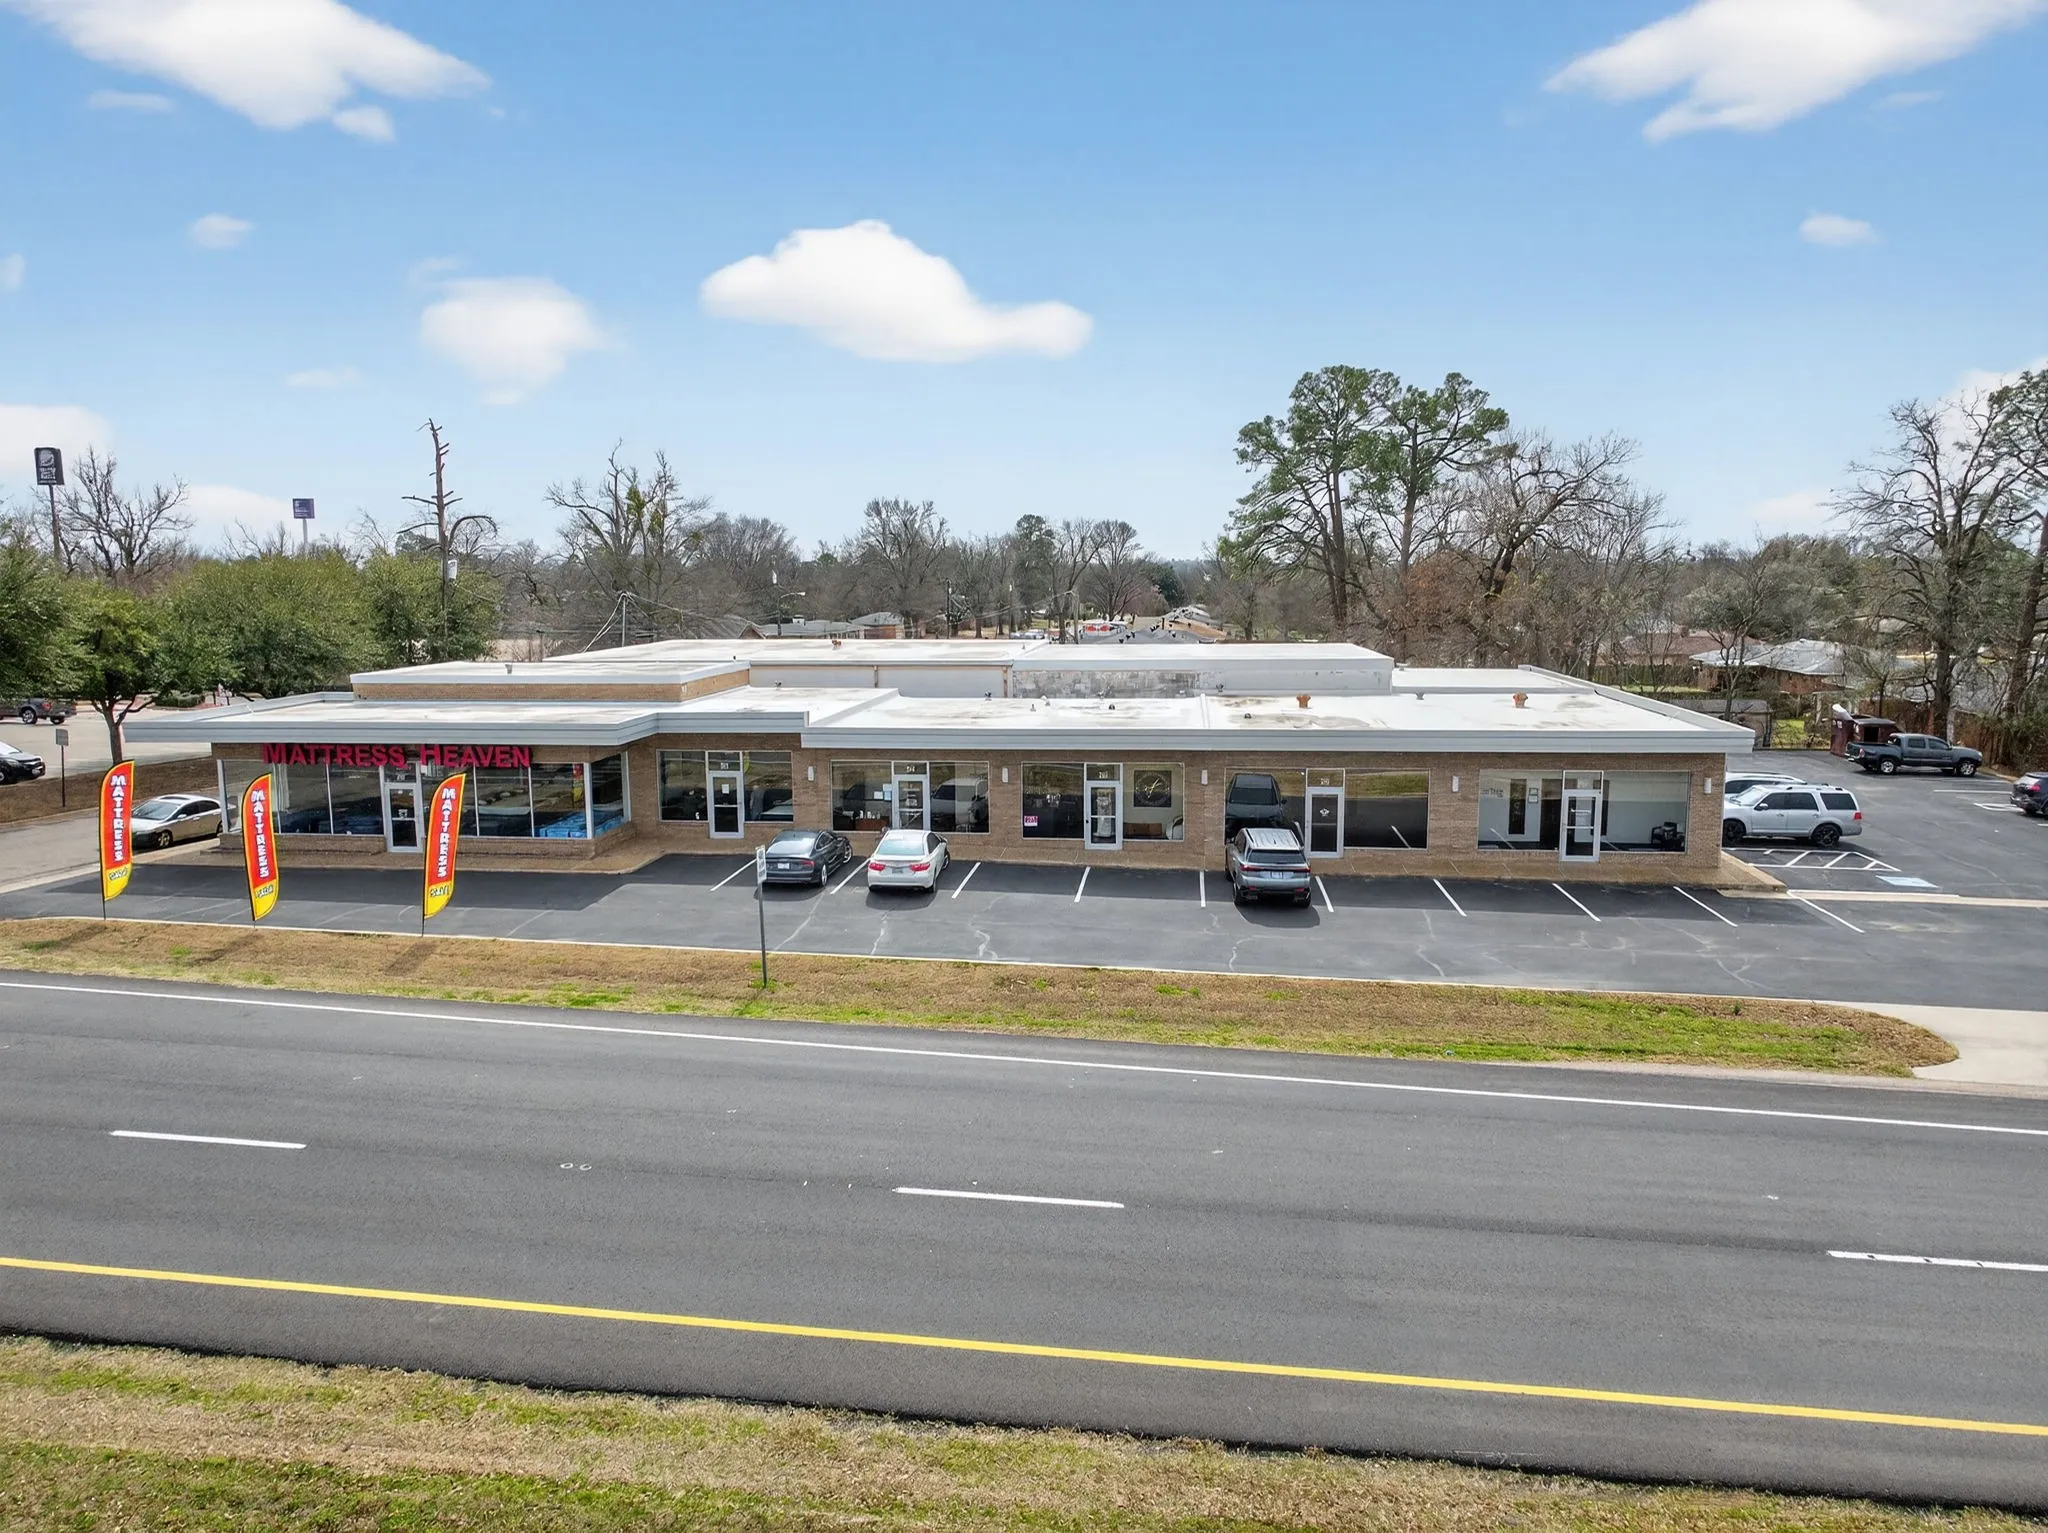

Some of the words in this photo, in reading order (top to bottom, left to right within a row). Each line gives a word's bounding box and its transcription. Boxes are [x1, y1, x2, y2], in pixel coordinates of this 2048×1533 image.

[262, 743, 408, 768] MATTRESS
[419, 744, 531, 768] HEAVEN
[110, 774, 127, 862] MATTRESS
[437, 787, 457, 878] MATTRESS
